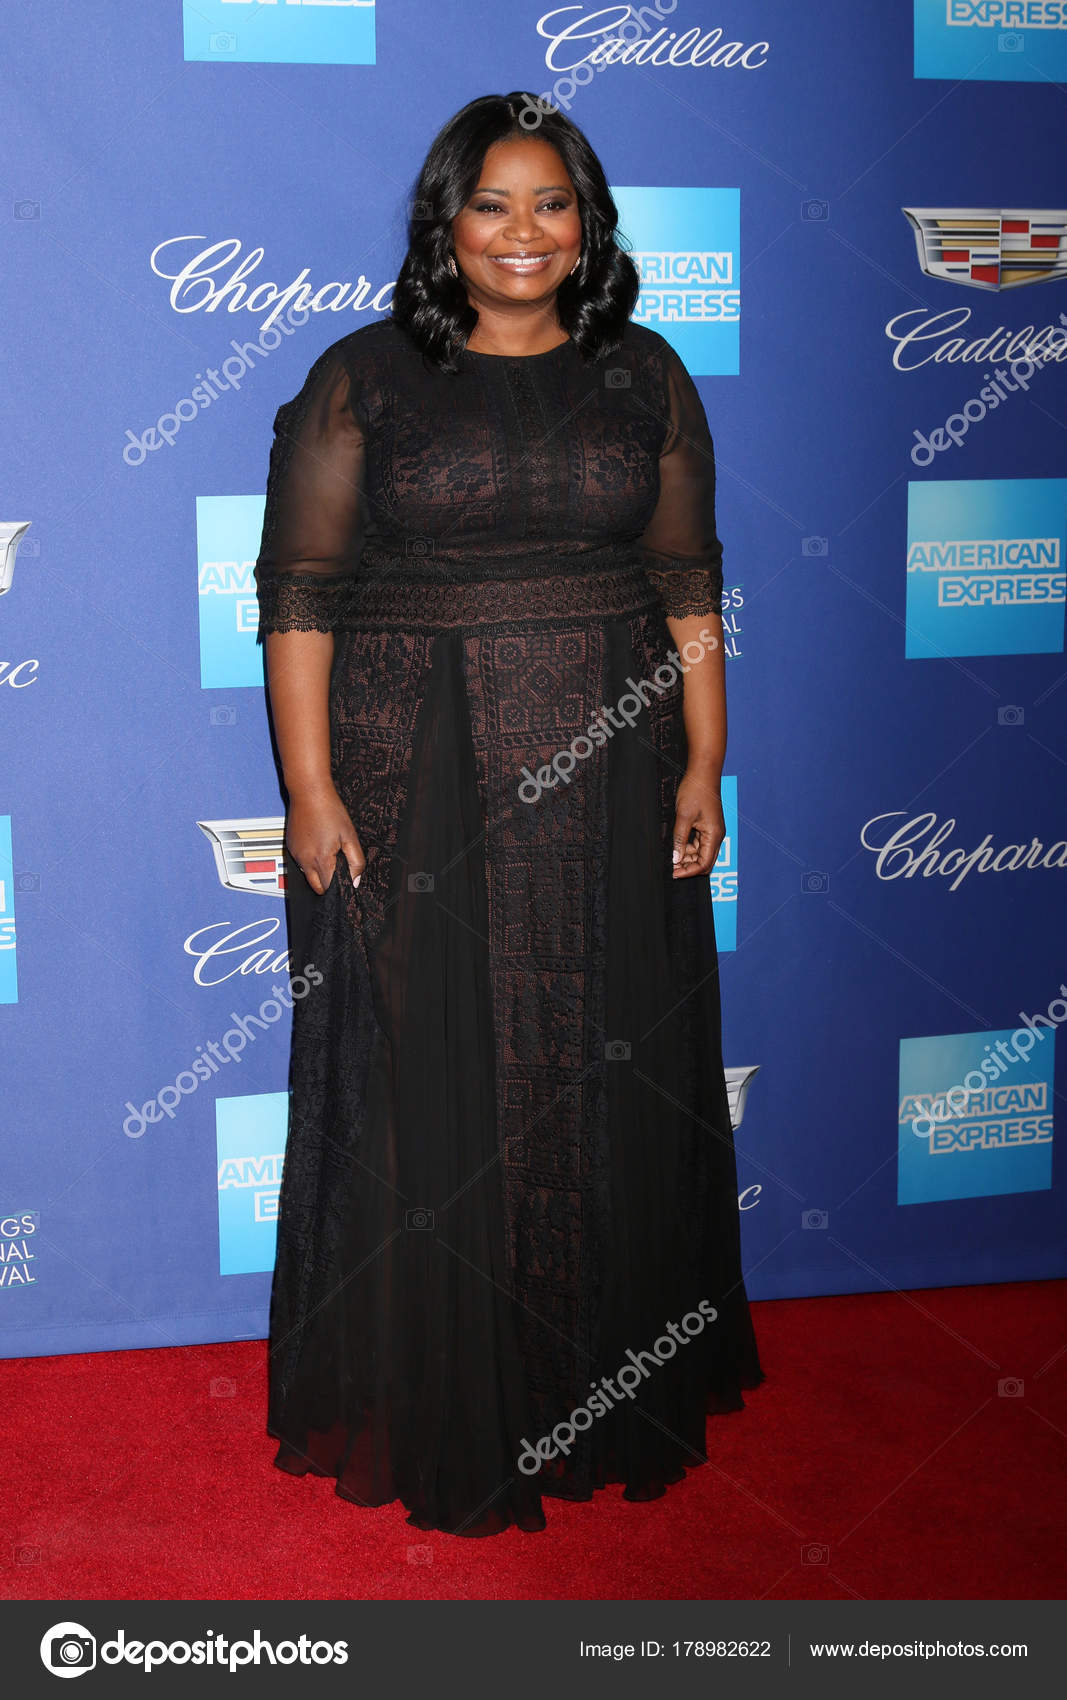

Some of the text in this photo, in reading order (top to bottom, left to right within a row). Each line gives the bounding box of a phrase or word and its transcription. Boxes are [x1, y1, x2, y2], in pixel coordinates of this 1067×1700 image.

[536, 5, 769, 72] Cadillac
[632, 252, 733, 284] RICAN
[907, 538, 1060, 572] AMERICAN
[938, 573, 1067, 607] EXPRESS
[899, 1082, 1047, 1124] AMERICAN
[930, 1115, 1054, 1155] EXPRESS
